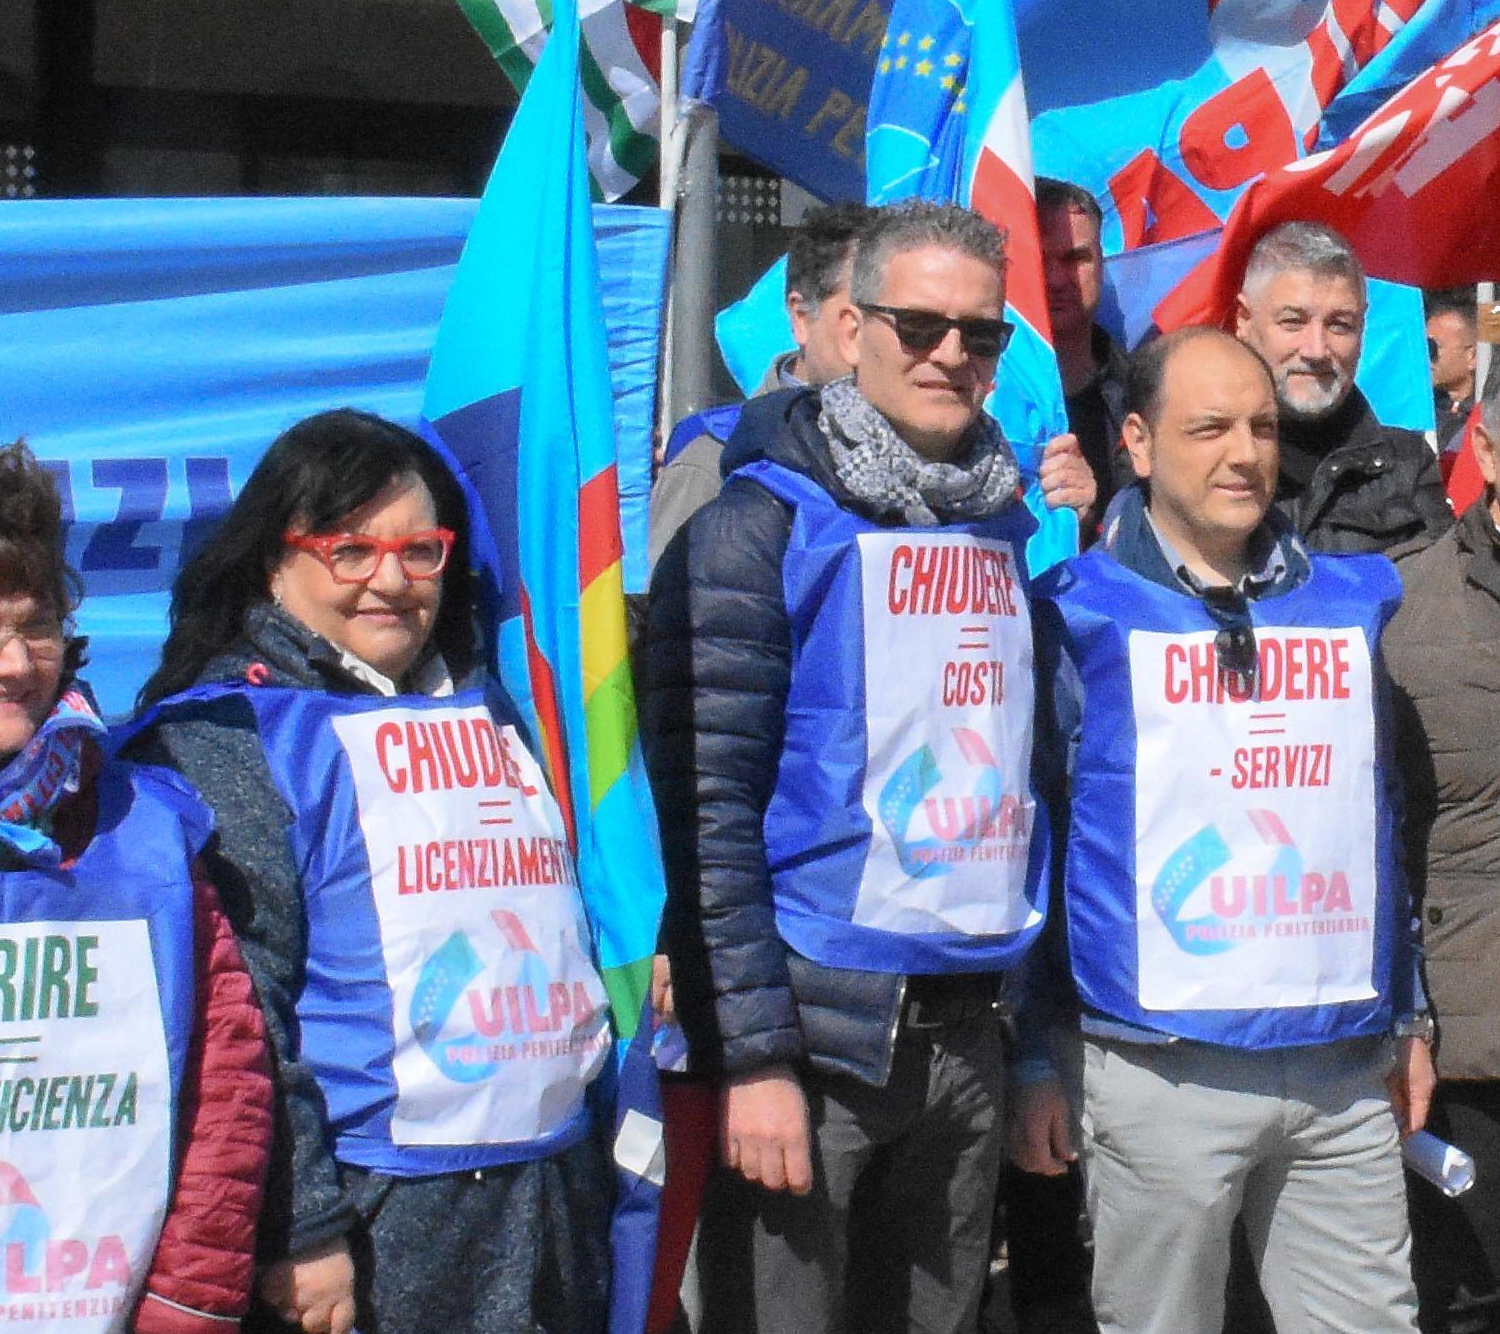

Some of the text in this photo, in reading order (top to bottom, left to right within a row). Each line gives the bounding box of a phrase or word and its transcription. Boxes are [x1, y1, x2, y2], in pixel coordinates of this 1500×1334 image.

[887, 544, 1017, 617] CHIUDERE
[942, 661, 1005, 707] COSTI
[1232, 744, 1332, 789] SERVIZI
[1209, 870, 1353, 920] UILPA
